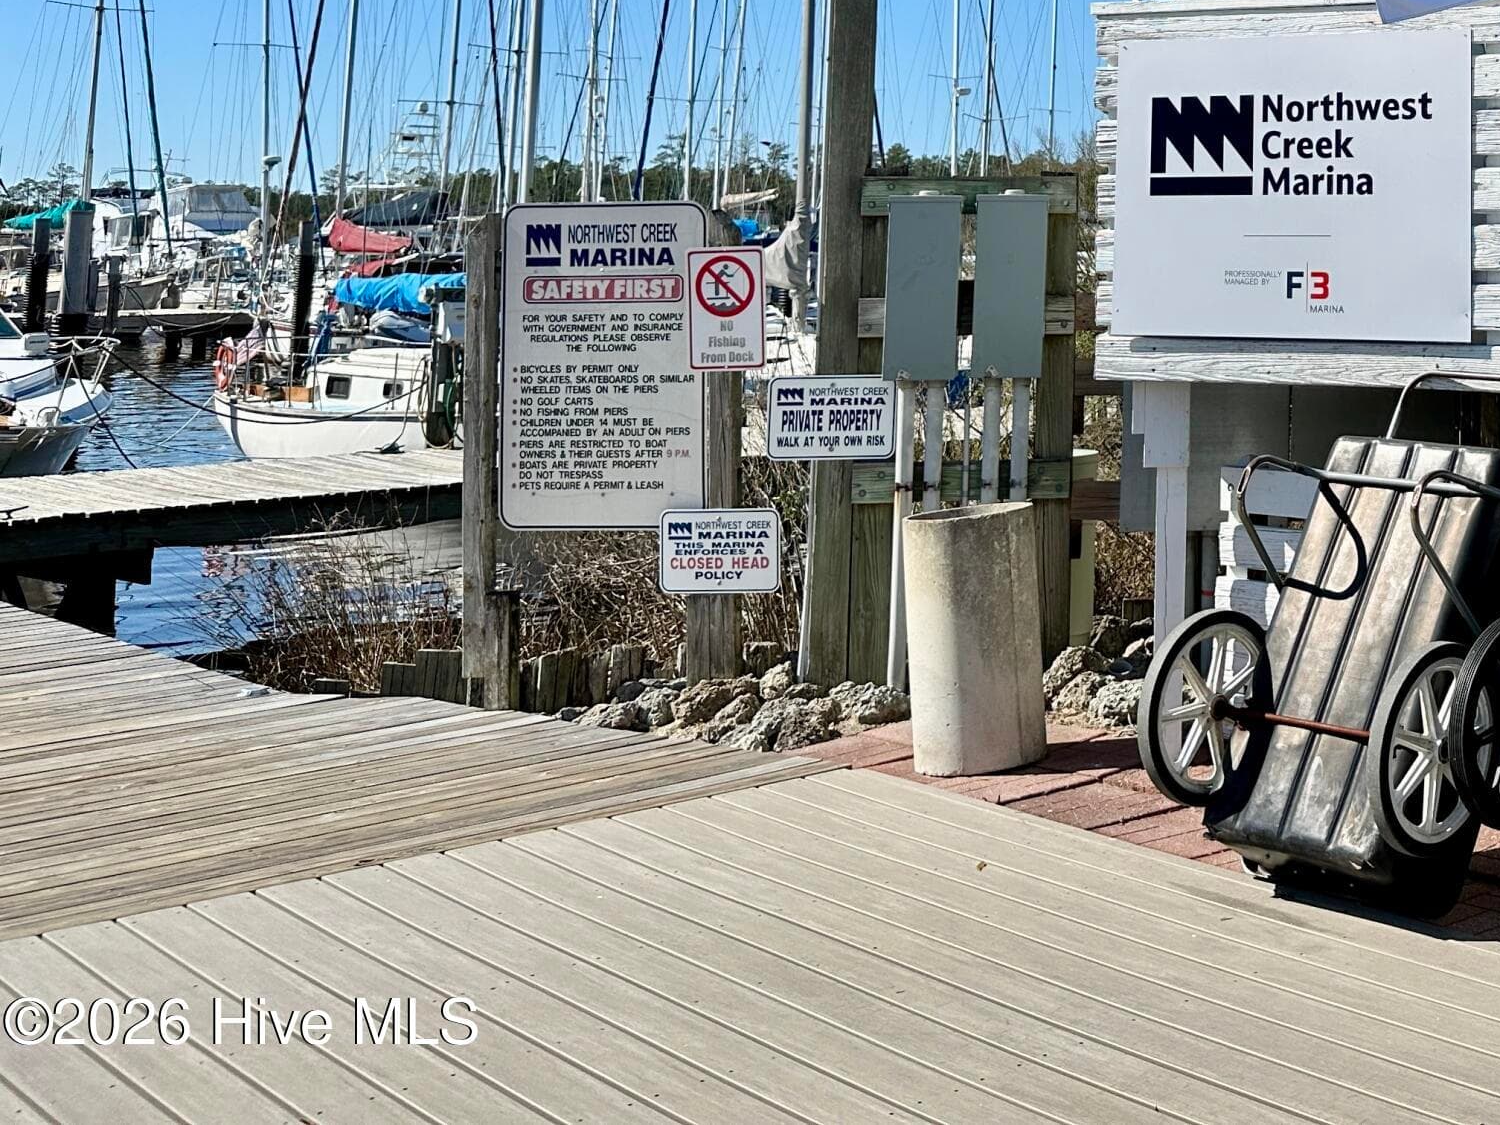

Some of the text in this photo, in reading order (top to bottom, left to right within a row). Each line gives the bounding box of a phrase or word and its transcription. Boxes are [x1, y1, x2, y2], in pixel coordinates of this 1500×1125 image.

[1261, 92, 1433, 123] Northwest
[1261, 129, 1354, 159] Creek
[1262, 166, 1374, 196] Marina
[568, 223, 678, 243] NORTHWEST CREEK
[570, 248, 675, 267] MARINA
[1224, 270, 1282, 278] PROFESSIONALLY
[1224, 278, 1271, 286] MANAGED BY
[531, 278, 676, 300] SAFETY FIRST
[1309, 305, 1345, 314] MARINA
[572, 314, 605, 322] SAFETY
[610, 314, 628, 322] AND
[633, 313, 645, 321] TO
[649, 313, 684, 321] COMPLY
[548, 324, 606, 333] GOVERNMENT
[611, 324, 629, 332] AND
[634, 323, 683, 331] INSURANCE
[720, 320, 734, 331] NO
[530, 333, 671, 342] REGULATIONS PLEASE OBSERVE
[708, 336, 746, 347] Fishing
[566, 344, 637, 352] THE FOLLOWING
[701, 351, 754, 363] From Dock
[520, 364, 639, 373] BICYCLES BY PERMIT ONLY
[520, 375, 695, 384] NO SKATES, SKATEBOARDS OR SIMILAR
[521, 386, 560, 394] WHEELED
[565, 386, 591, 394] ITEMS
[613, 385, 629, 393] THE
[634, 385, 659, 393] PIERS
[809, 387, 889, 396] NORTHWEST CREEK
[520, 397, 594, 406] NO GOLF CARTS
[810, 397, 886, 406] MARINA
[520, 407, 629, 416] NO FISHING FROM PIERS
[520, 418, 654, 427] CHILDREN UNDER 14 MUST BE
[782, 409, 882, 432] PRIVATE PROPERTY
[520, 427, 691, 437] ACCOMPANIED BY AN ADULT ON PIERS
[519, 439, 668, 448] PIERS ARE RESTRICTED TO BOAT
[777, 435, 885, 447] WALK AT YOUR OWN RISK
[519, 450, 557, 458] OWNERS
[569, 450, 593, 458] THEIR
[596, 450, 631, 458] GUESTS
[635, 450, 663, 458] AFTER
[666, 450, 673, 458] 9
[674, 450, 691, 458] P.M.
[519, 460, 658, 469] BOATS ARE PRIVATE PROPERTY
[519, 471, 604, 479] DO NOT TRESPASS
[519, 482, 541, 490] PETS
[544, 482, 581, 490] REQUIRE
[593, 481, 624, 489] PERMIT
[635, 481, 664, 489] LEASH
[695, 521, 771, 530] NORTHWEST CREEK
[698, 531, 769, 539] MARINA
[671, 557, 769, 569] CLOSED HEAD
[695, 571, 743, 580] POLICY
